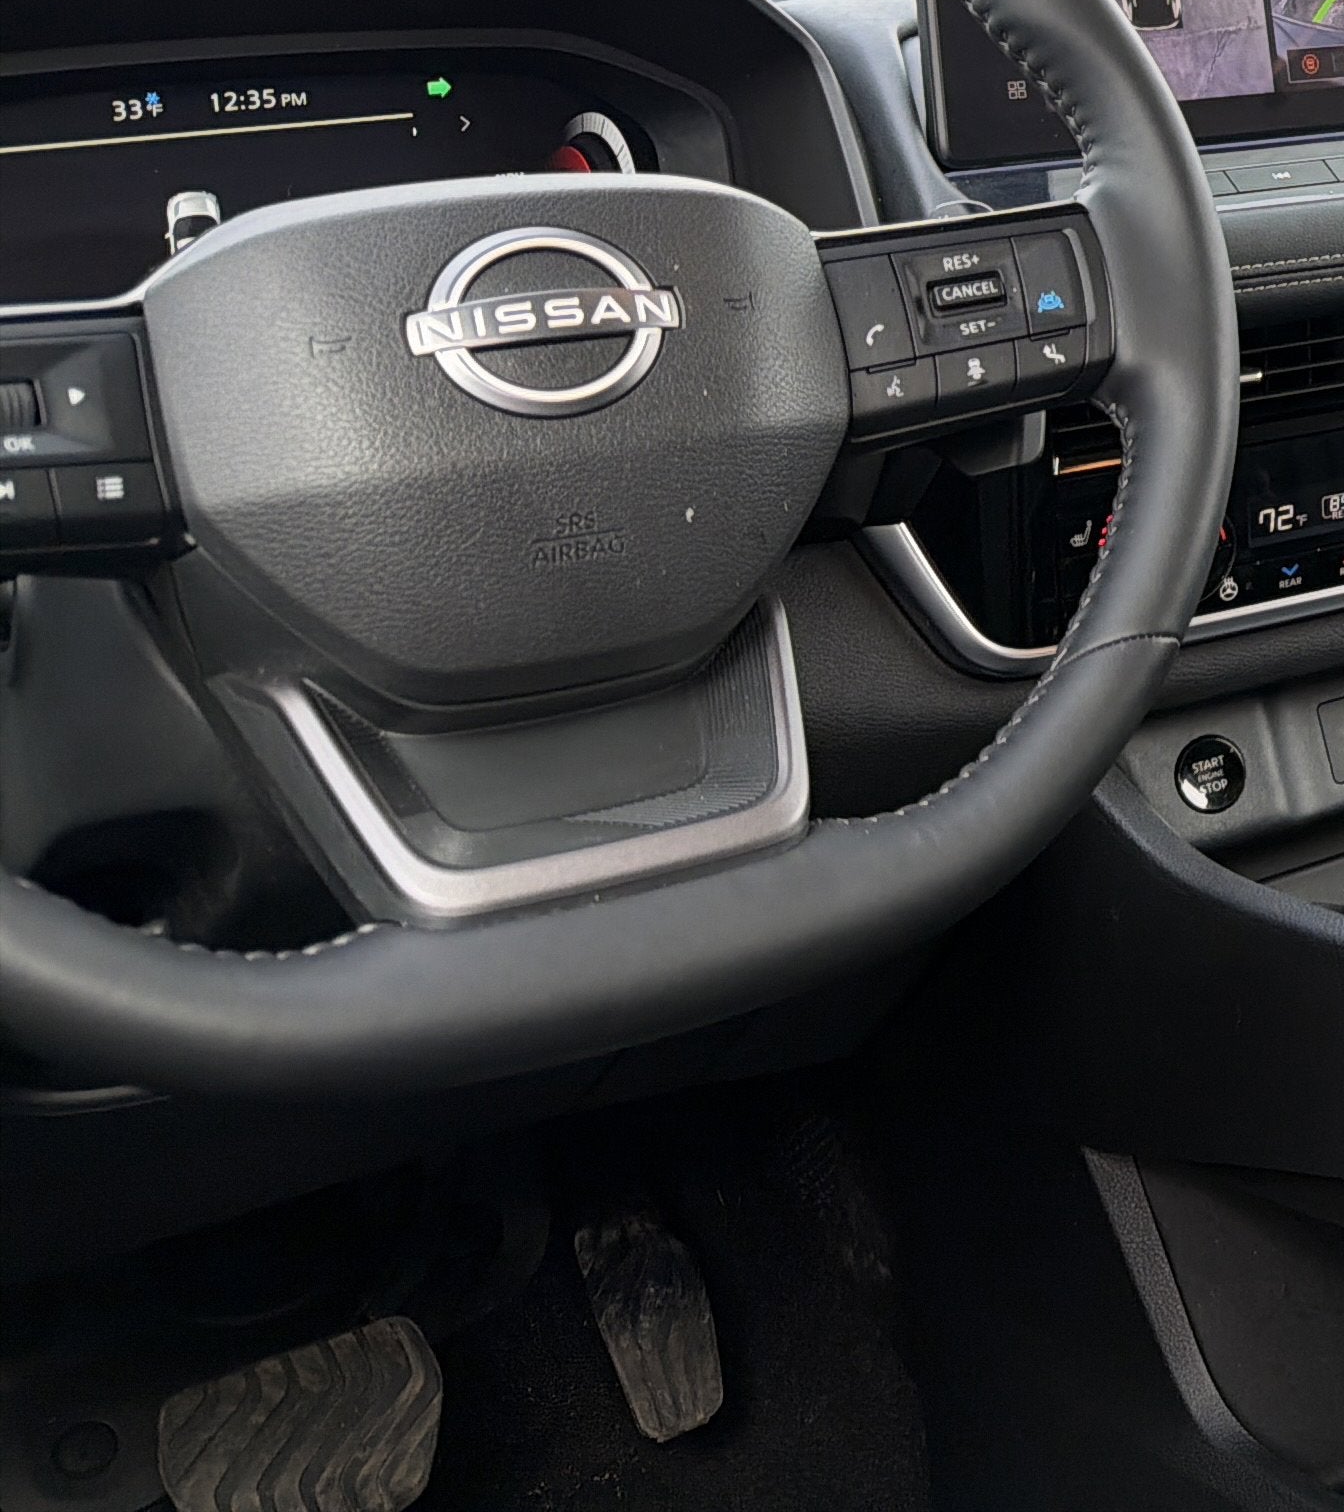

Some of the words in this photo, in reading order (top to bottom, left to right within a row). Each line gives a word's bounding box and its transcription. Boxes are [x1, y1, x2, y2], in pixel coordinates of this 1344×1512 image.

[210, 88, 277, 113] 12:35
[281, 91, 308, 108] PM
[941, 280, 999, 301] CANCEL
[415, 291, 671, 347] NISSAN
[3, 435, 35, 453] OK
[555, 511, 596, 535] SRS
[532, 535, 625, 567] AIRBAG
[1278, 576, 1303, 589] REAR
[1191, 754, 1225, 776] START
[1197, 768, 1225, 783] ENGINE
[1199, 778, 1228, 794] STOP
